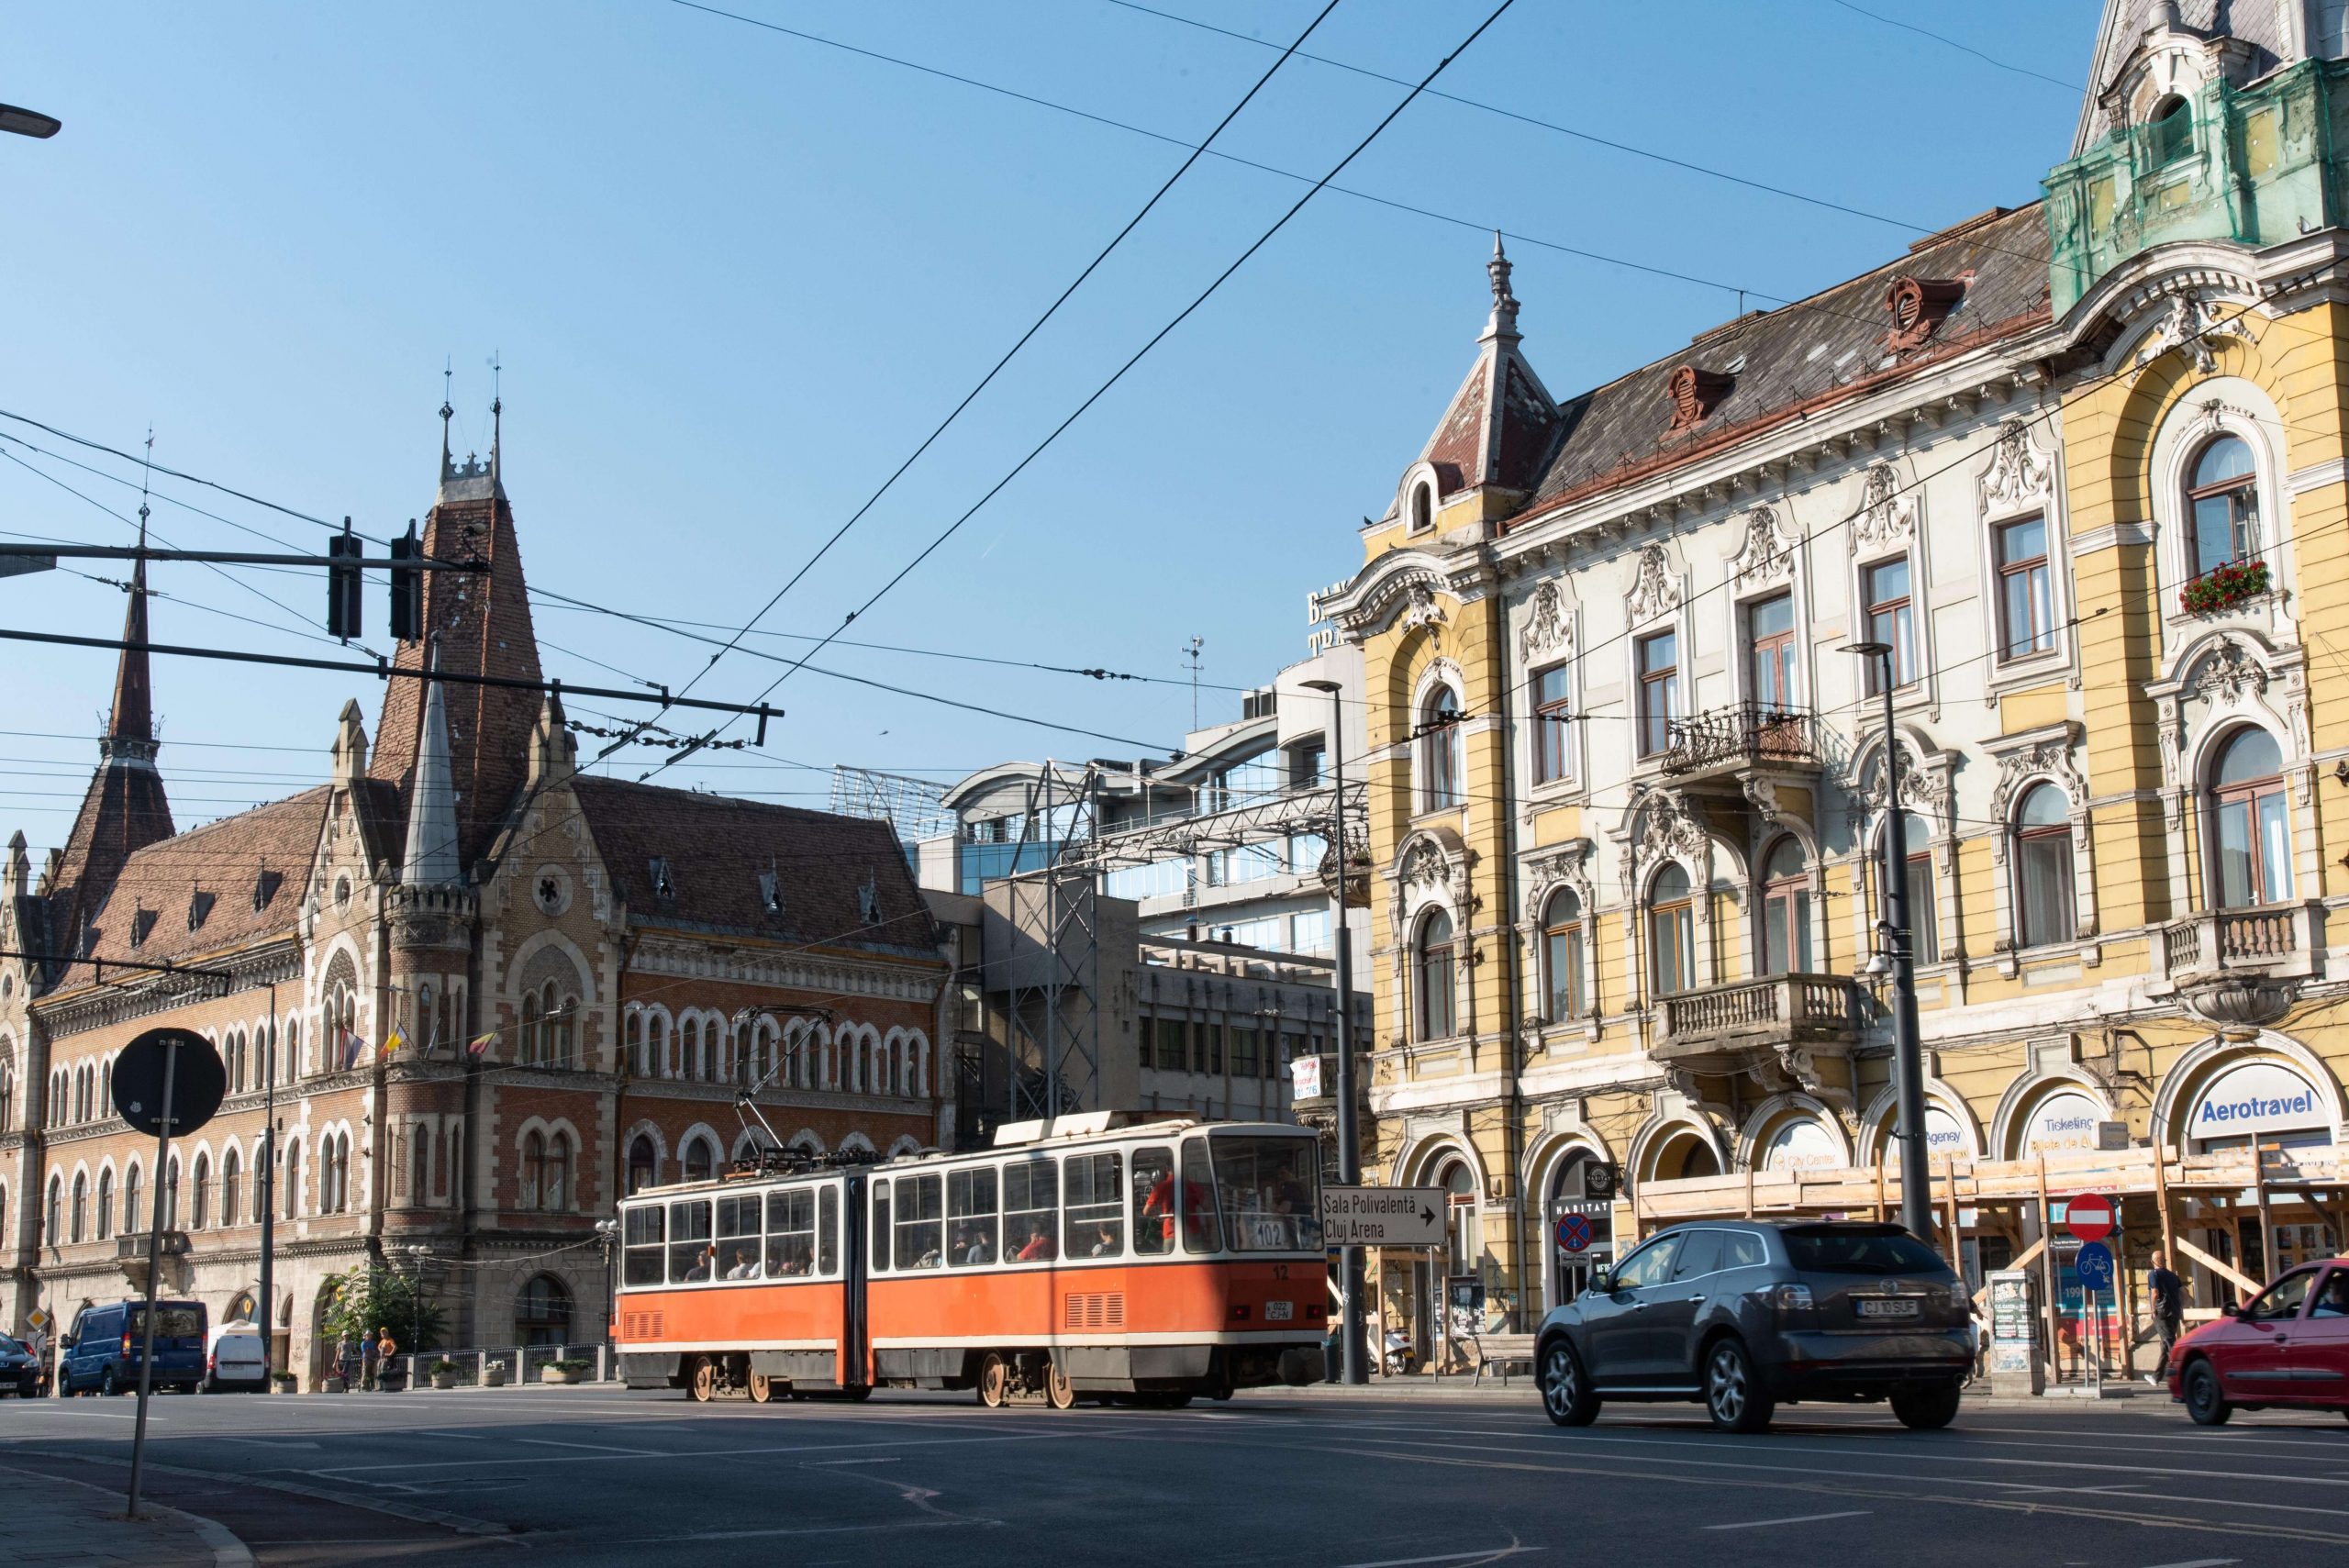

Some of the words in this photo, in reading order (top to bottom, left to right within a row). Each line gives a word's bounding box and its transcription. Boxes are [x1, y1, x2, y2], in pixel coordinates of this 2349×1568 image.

[2202, 1090, 2312, 1123] Aerotravel
[2044, 1117, 2094, 1132] Ticketing
[1926, 1130, 1961, 1146] Agency
[1807, 1153, 1836, 1166] Center
[1324, 1195, 1349, 1214] Sala
[1353, 1195, 1416, 1214] Polivalentă
[1556, 1202, 1608, 1215] HABITAT
[1257, 1224, 1282, 1246] 102
[1325, 1219, 1347, 1243] Cluj
[1351, 1220, 1384, 1239] Arena
[1273, 1264, 1289, 1281] 12
